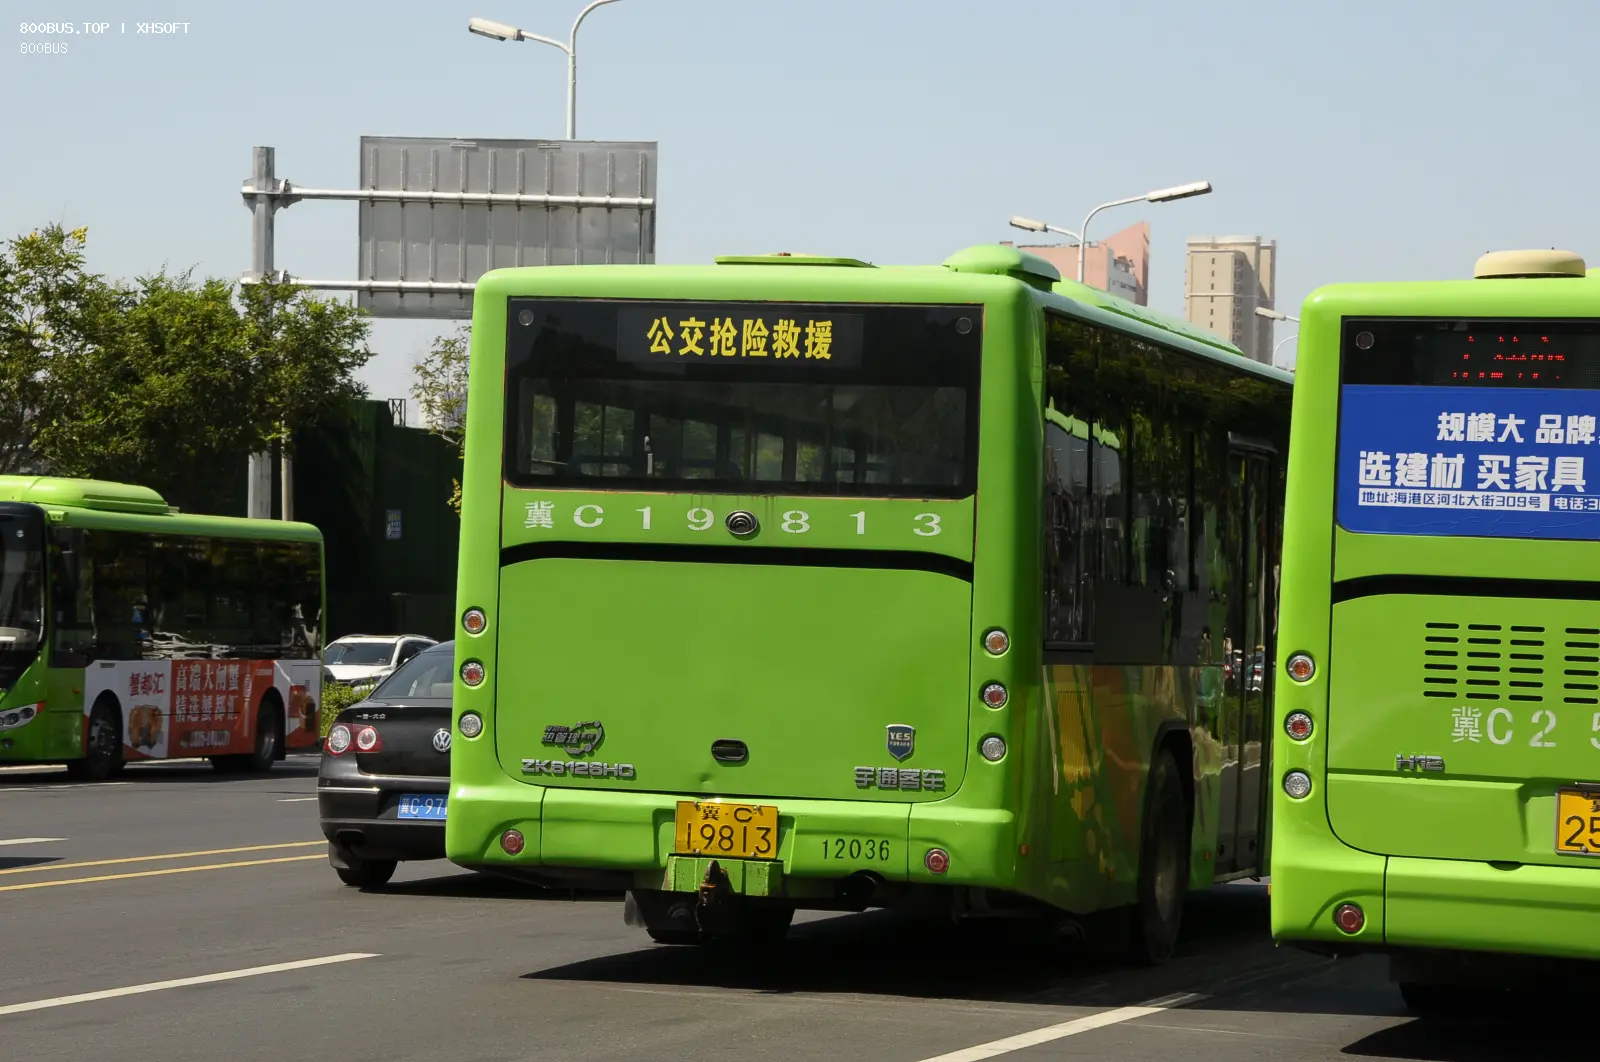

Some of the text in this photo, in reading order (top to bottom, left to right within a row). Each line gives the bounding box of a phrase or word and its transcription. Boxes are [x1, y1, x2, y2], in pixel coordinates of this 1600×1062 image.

[646, 316, 833, 360] 公交抢险救援
[1436, 411, 1600, 445] 规模大 品牌
[1358, 450, 1587, 493] 选建材 买家具
[1360, 490, 1543, 509] 地址:海港区河北大街309号
[1554, 496, 1600, 511] 电话:3
[889, 732, 911, 741] YES
[854, 765, 946, 790] 宇通客车
[686, 822, 772, 854] 19813
[822, 838, 890, 861] 12036
